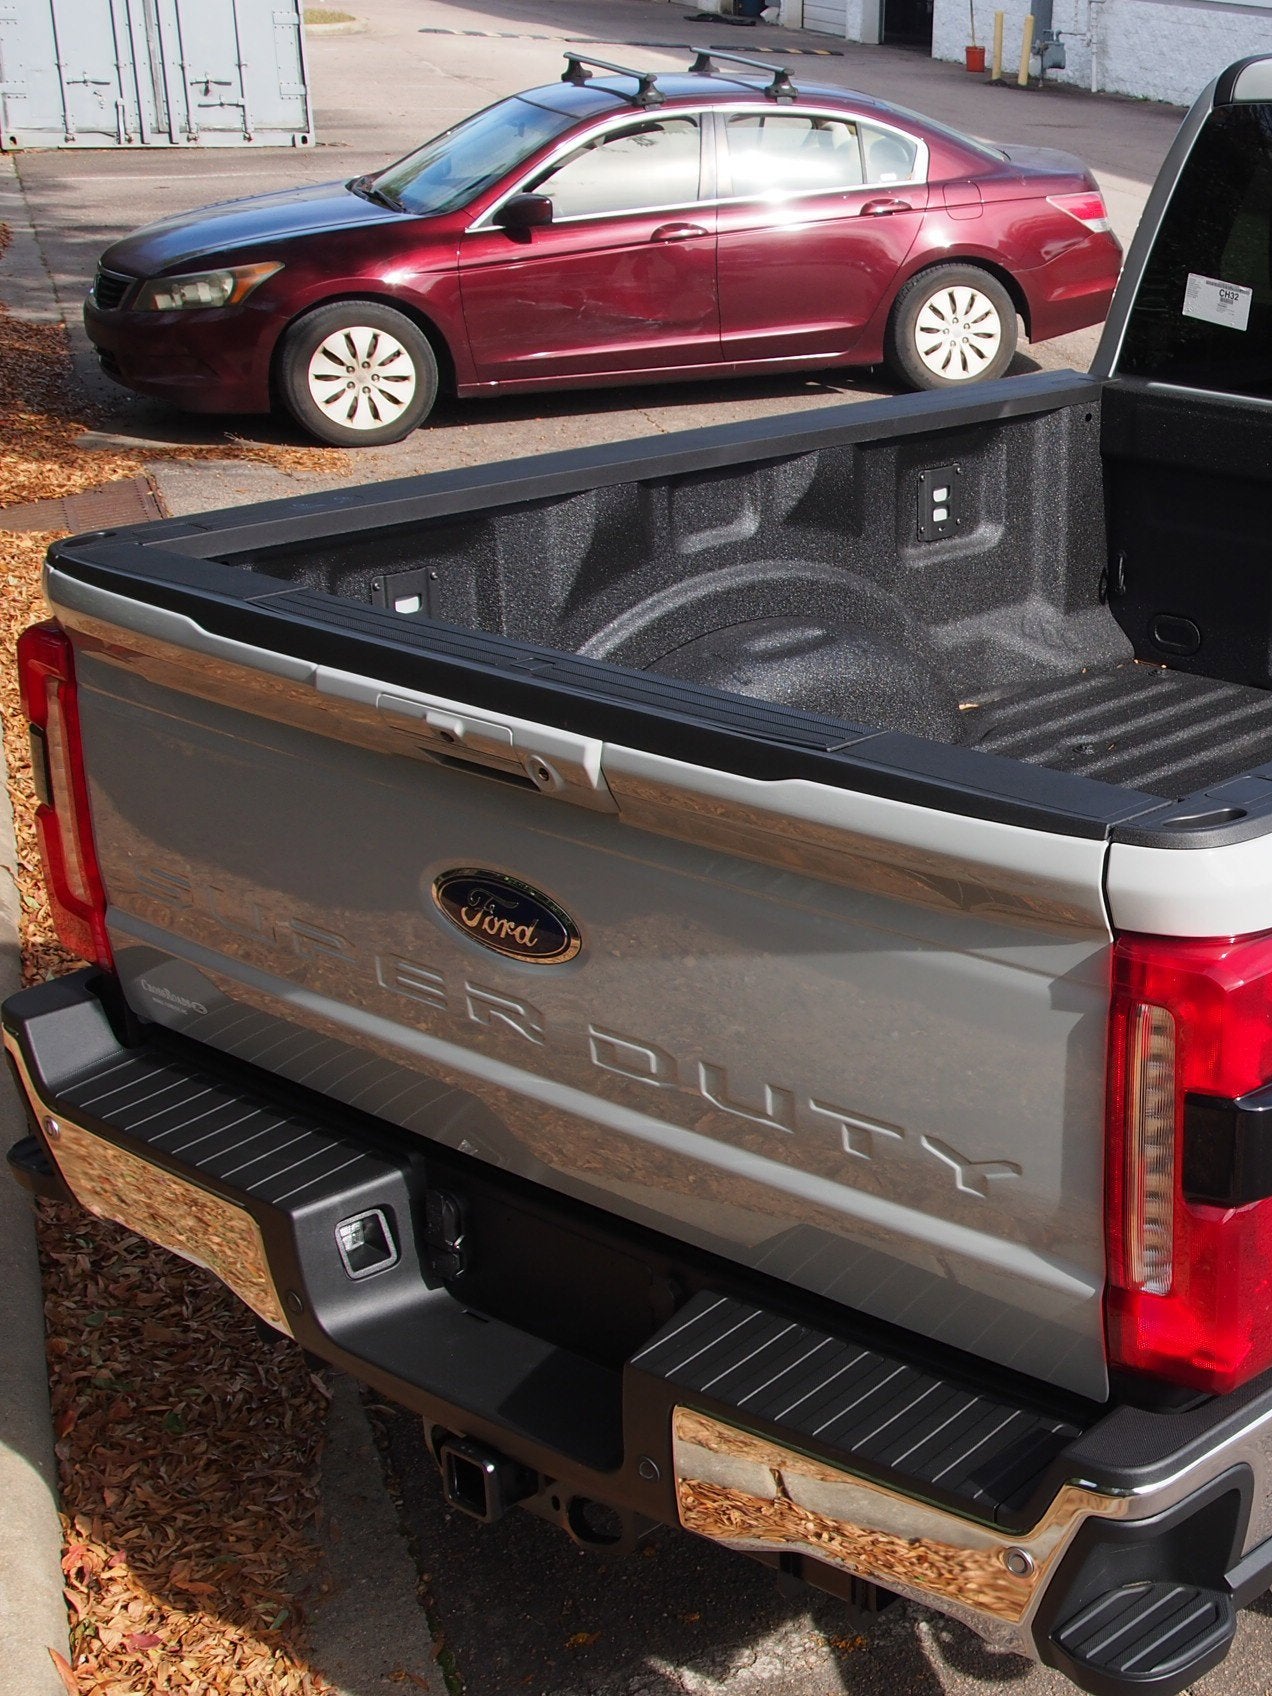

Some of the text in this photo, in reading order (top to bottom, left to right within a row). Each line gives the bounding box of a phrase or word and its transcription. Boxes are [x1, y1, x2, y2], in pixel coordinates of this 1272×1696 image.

[1219, 288, 1240, 302] CH32
[460, 887, 539, 947] Ford
[134, 862, 1023, 1199] SUPER DUTY
